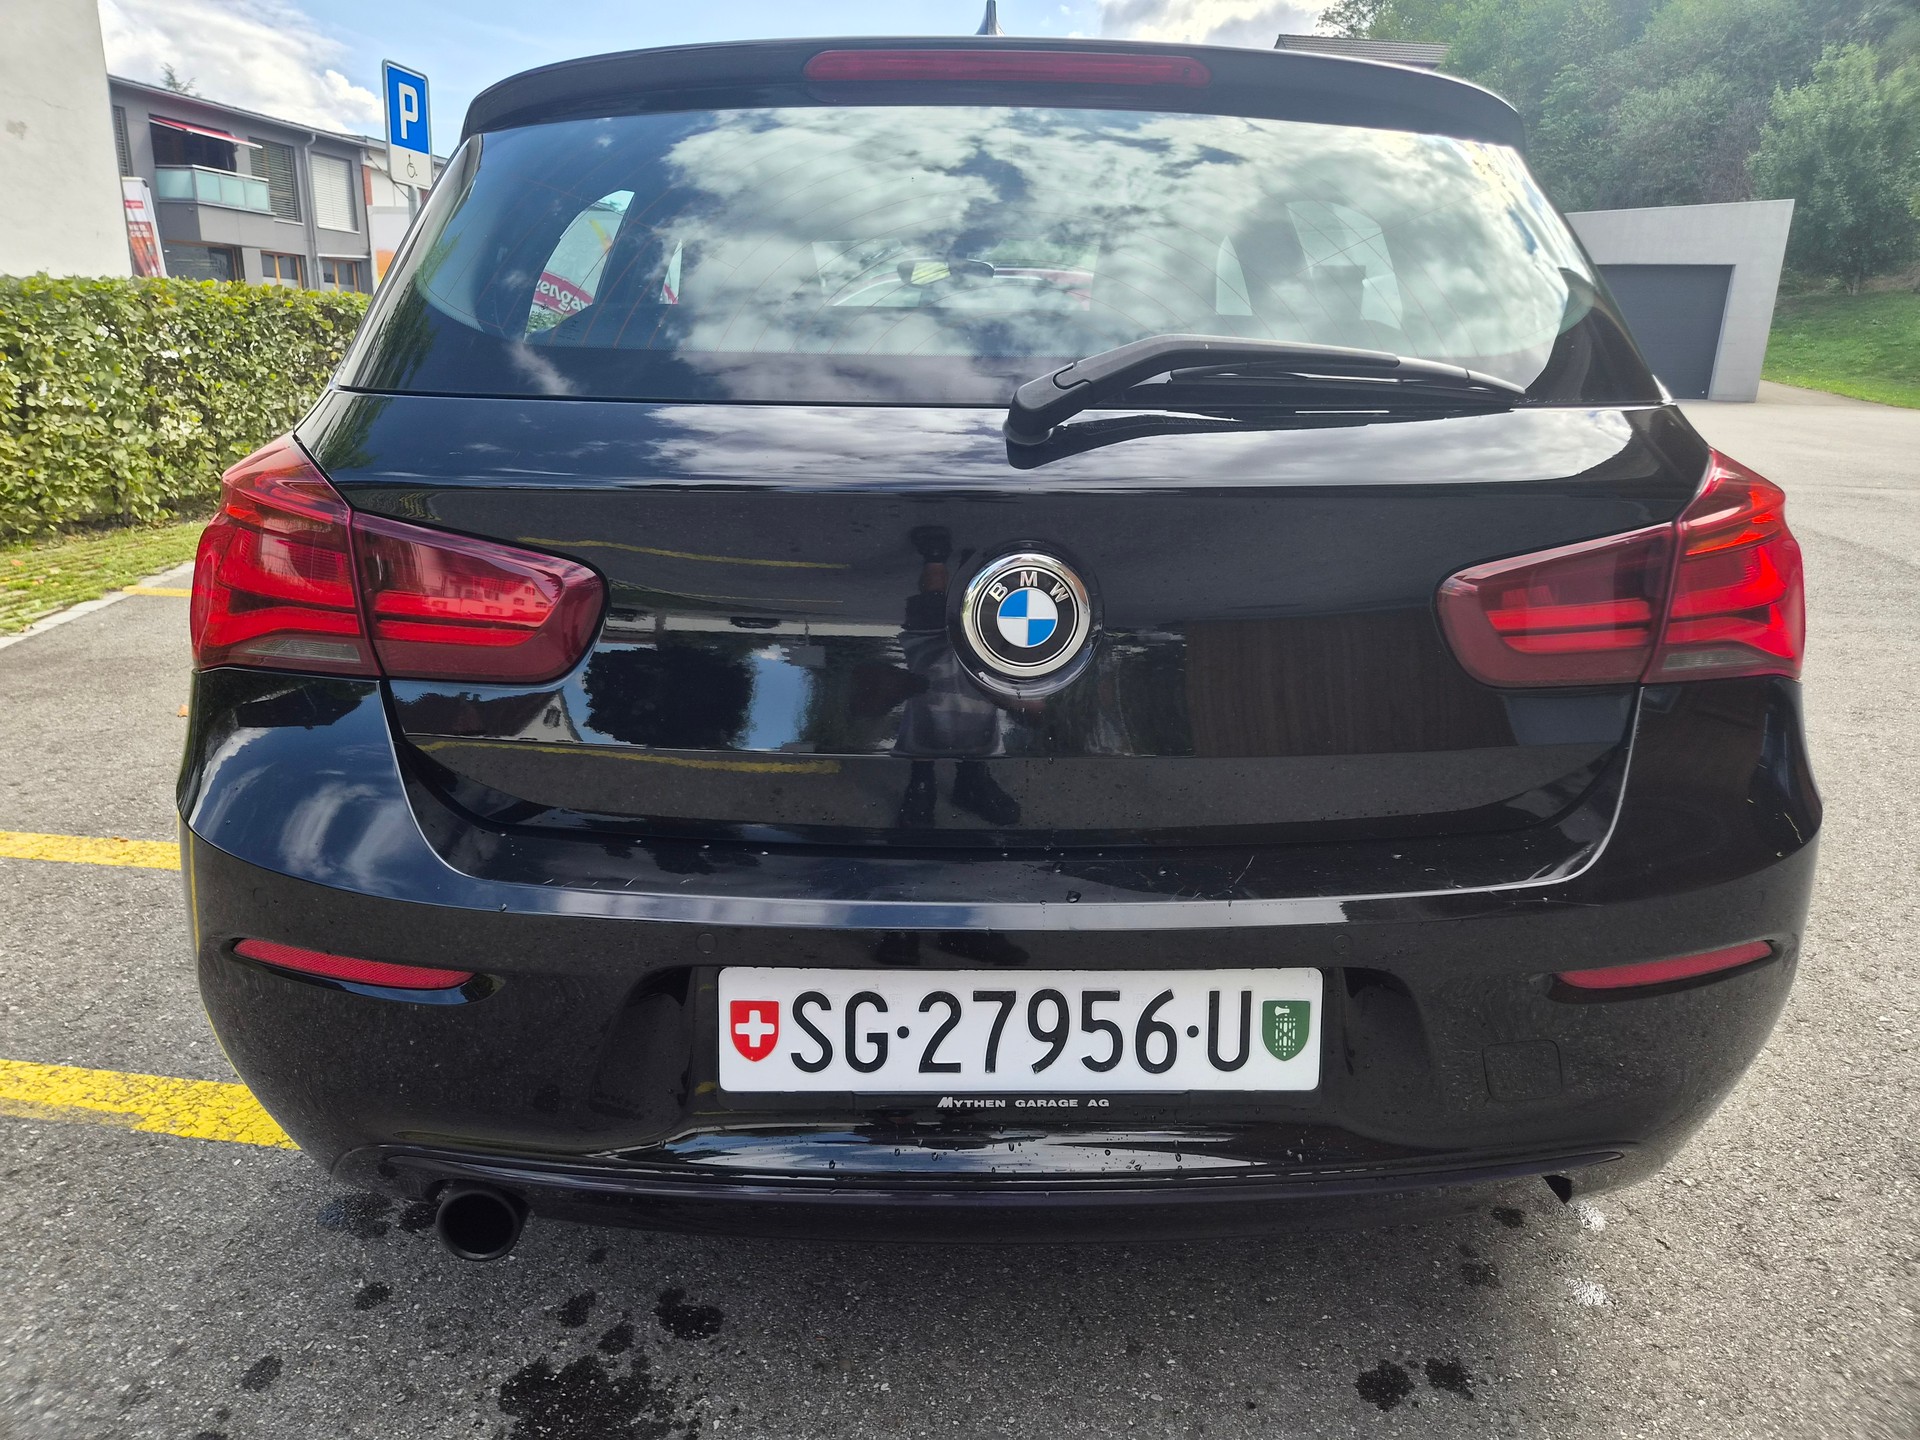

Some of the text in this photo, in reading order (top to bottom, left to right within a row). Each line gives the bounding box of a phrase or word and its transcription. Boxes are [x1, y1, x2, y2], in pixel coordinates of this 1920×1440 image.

[398, 82, 419, 140] P
[988, 571, 1069, 603] BMW
[937, 1096, 1110, 1108] MYTHEN GARAGE AG
